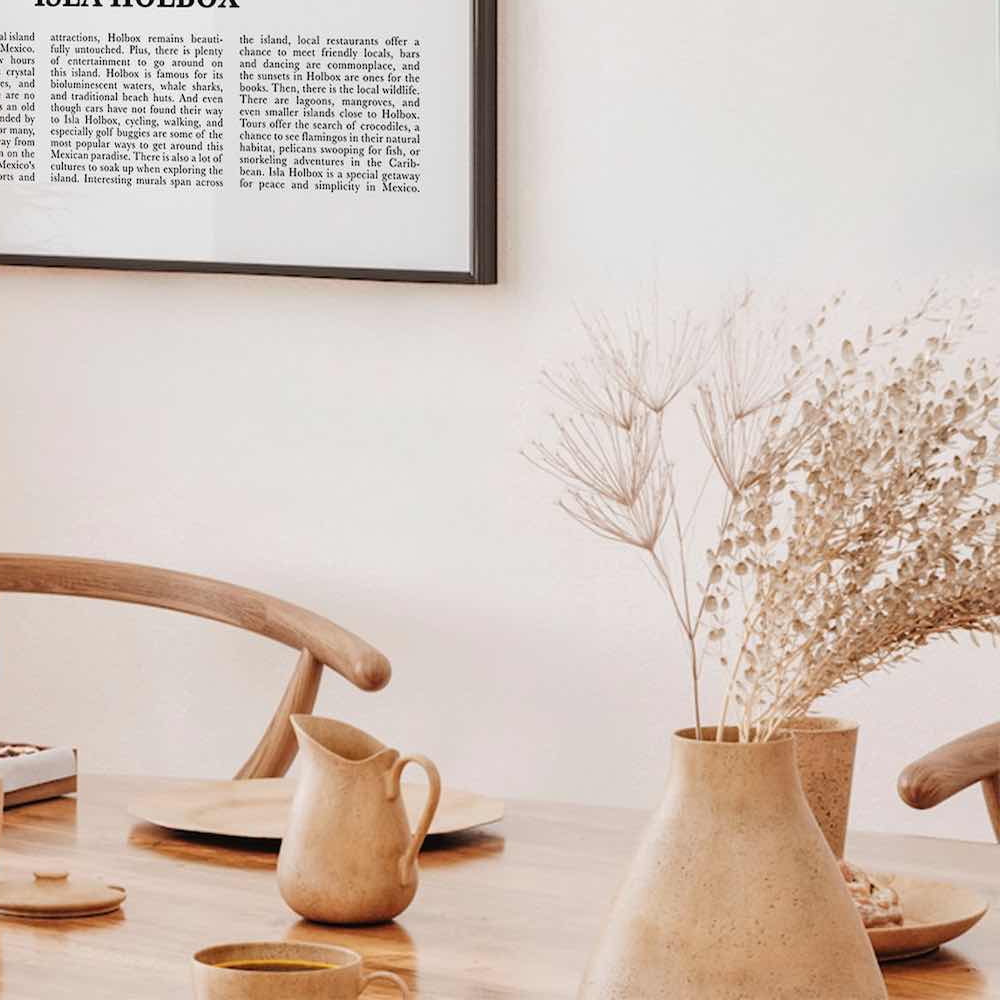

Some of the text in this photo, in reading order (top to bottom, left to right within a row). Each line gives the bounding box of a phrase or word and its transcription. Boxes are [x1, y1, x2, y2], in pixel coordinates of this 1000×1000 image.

[9, 32, 35, 41] island
[50, 33, 224, 43] attractions, Holbox remains beauti-
[239, 35, 253, 44] the
[260, 35, 292, 46] island,
[297, 36, 320, 45] local
[326, 37, 379, 45] restaurants
[385, 37, 407, 46] offer
[0, 43, 34, 52] Mexico.
[50, 44, 223, 57] fully untouched. Plus, there is plenty
[239, 47, 420, 60] chance to meet friendly locals, bars
[50, 56, 59, 65] of
[67, 56, 130, 66] entertainment
[137, 58, 147, 66] to
[153, 60, 165, 68] go
[172, 58, 204, 67] around
[239, 59, 257, 68] and
[263, 60, 300, 71] dancing
[327, 60, 398, 72] commonplace,
[402, 61, 420, 70] and
[6, 67, 35, 78] crystal
[50, 68, 224, 79] this island. Holbox is famous for its
[18, 79, 35, 88] and
[50, 80, 224, 92] bioluminescent waters, whale sharks,
[50, 92, 67, 100] and
[71, 92, 118, 101] traditional
[122, 93, 149, 102] beach
[153, 93, 174, 102] huts.
[179, 93, 198, 102] And
[240, 95, 267, 104] There
[296, 96, 336, 108] lagoons,
[341, 99, 397, 109] mangroves,
[402, 98, 420, 107] and
[265, 108, 298, 117] smaller
[303, 108, 335, 118] islands
[339, 109, 363, 118] close
[367, 110, 377, 118] to
[382, 110, 419, 119] Holbox.
[24, 114, 34, 125] by
[50, 115, 224, 128] to Isla Holbox, cycling, walking, and
[9, 128, 35, 137] many,
[50, 139, 223, 152] most popular ways to get around this
[239, 143, 277, 154] habitat,
[279, 144, 317, 156] pelicans
[320, 145, 365, 157] swooping
[368, 146, 381, 155] for
[386, 146, 407, 157] fish,
[239, 155, 418, 168] snorkeling adventures in the Carib-
[19, 172, 35, 181] and
[50, 174, 81, 183] island.
[84, 174, 132, 186] Interesting
[136, 176, 167, 185] murals
[170, 179, 192, 188] span
[239, 179, 419, 193] for peace and simplicity in Mexico.
